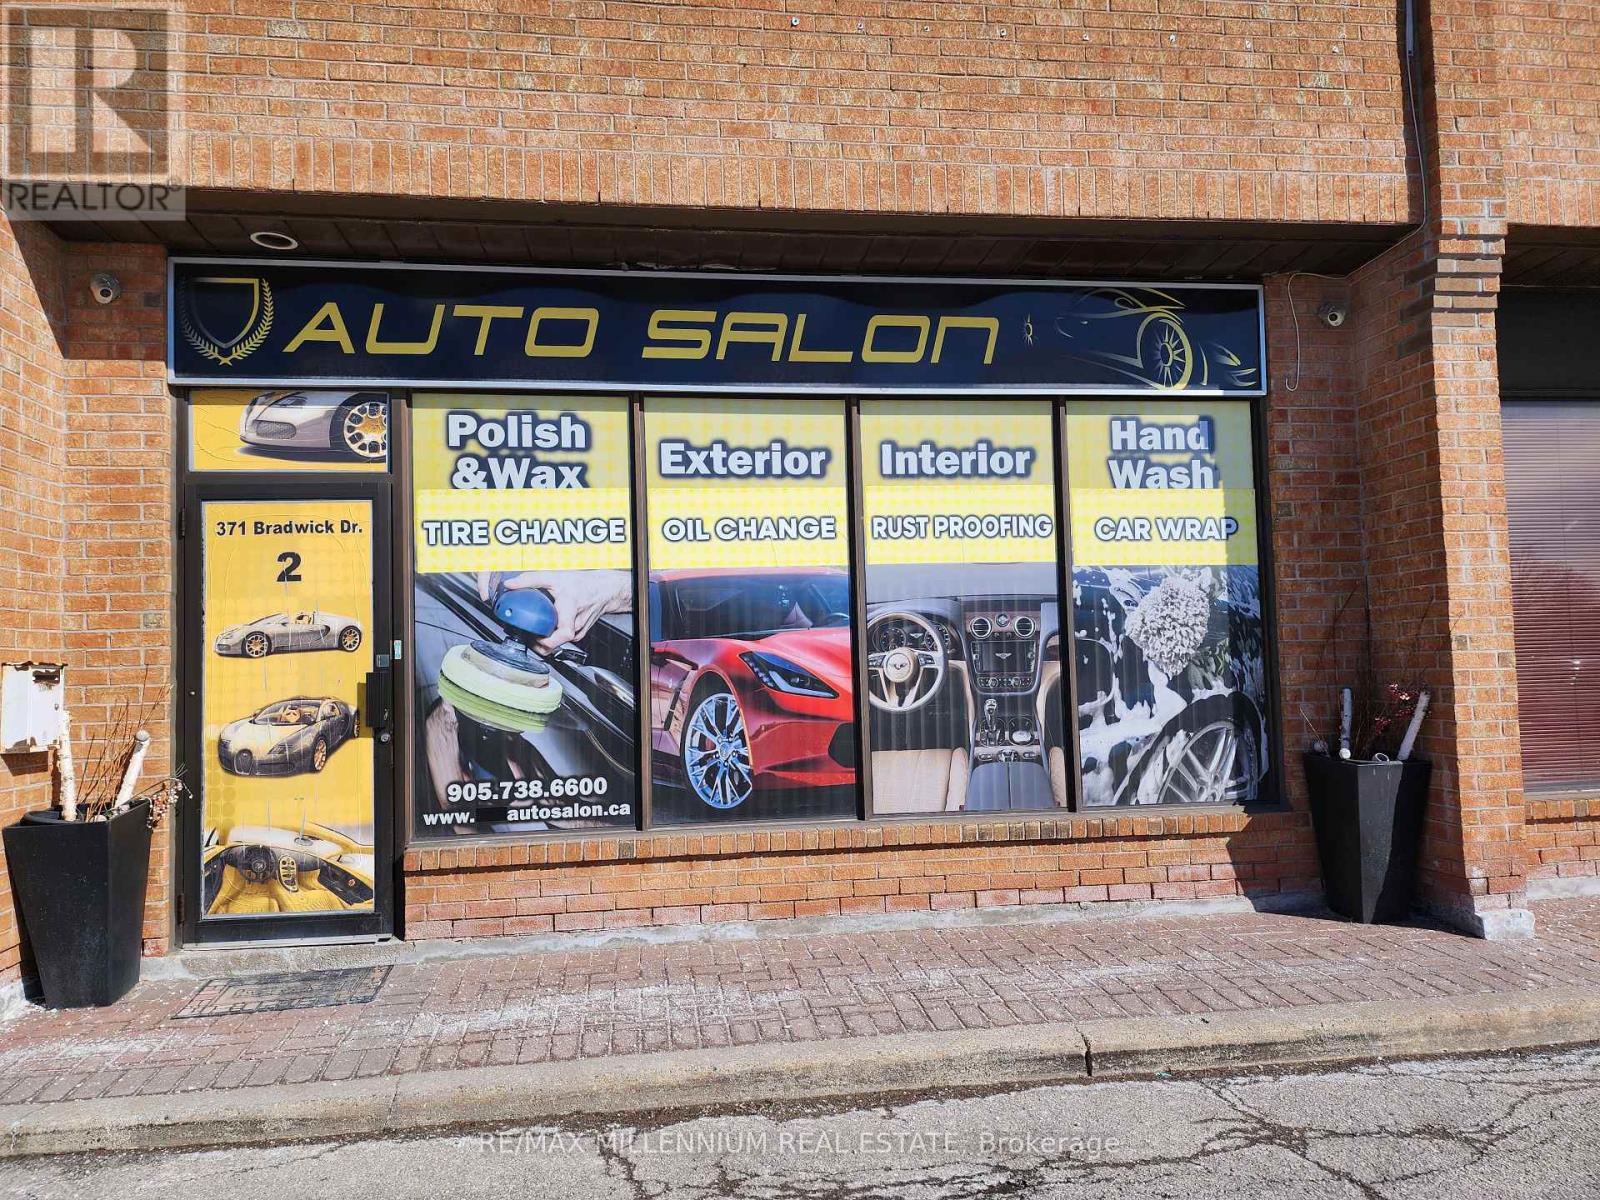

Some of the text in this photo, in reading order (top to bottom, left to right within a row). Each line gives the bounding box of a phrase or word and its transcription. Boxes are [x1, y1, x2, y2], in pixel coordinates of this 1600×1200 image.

[282, 302, 600, 358] AUTO
[447, 414, 587, 449] Polish
[1111, 420, 1210, 451] Hand
[451, 456, 584, 489] &Wax
[659, 442, 827, 476] Exterior
[881, 443, 1032, 475] Interior
[1107, 459, 1215, 490] Wash
[216, 518, 363, 536] 371 Bradwick Dr.
[422, 519, 626, 545] TIRE CHANGE
[662, 516, 836, 541] OIL CHANGE
[872, 515, 1053, 538] RUST PROOFING
[1094, 517, 1238, 541] CAR WRAP
[276, 551, 302, 583] 2
[447, 776, 608, 803] 905.738.6600
[423, 802, 631, 826] www. autosalon.ca
